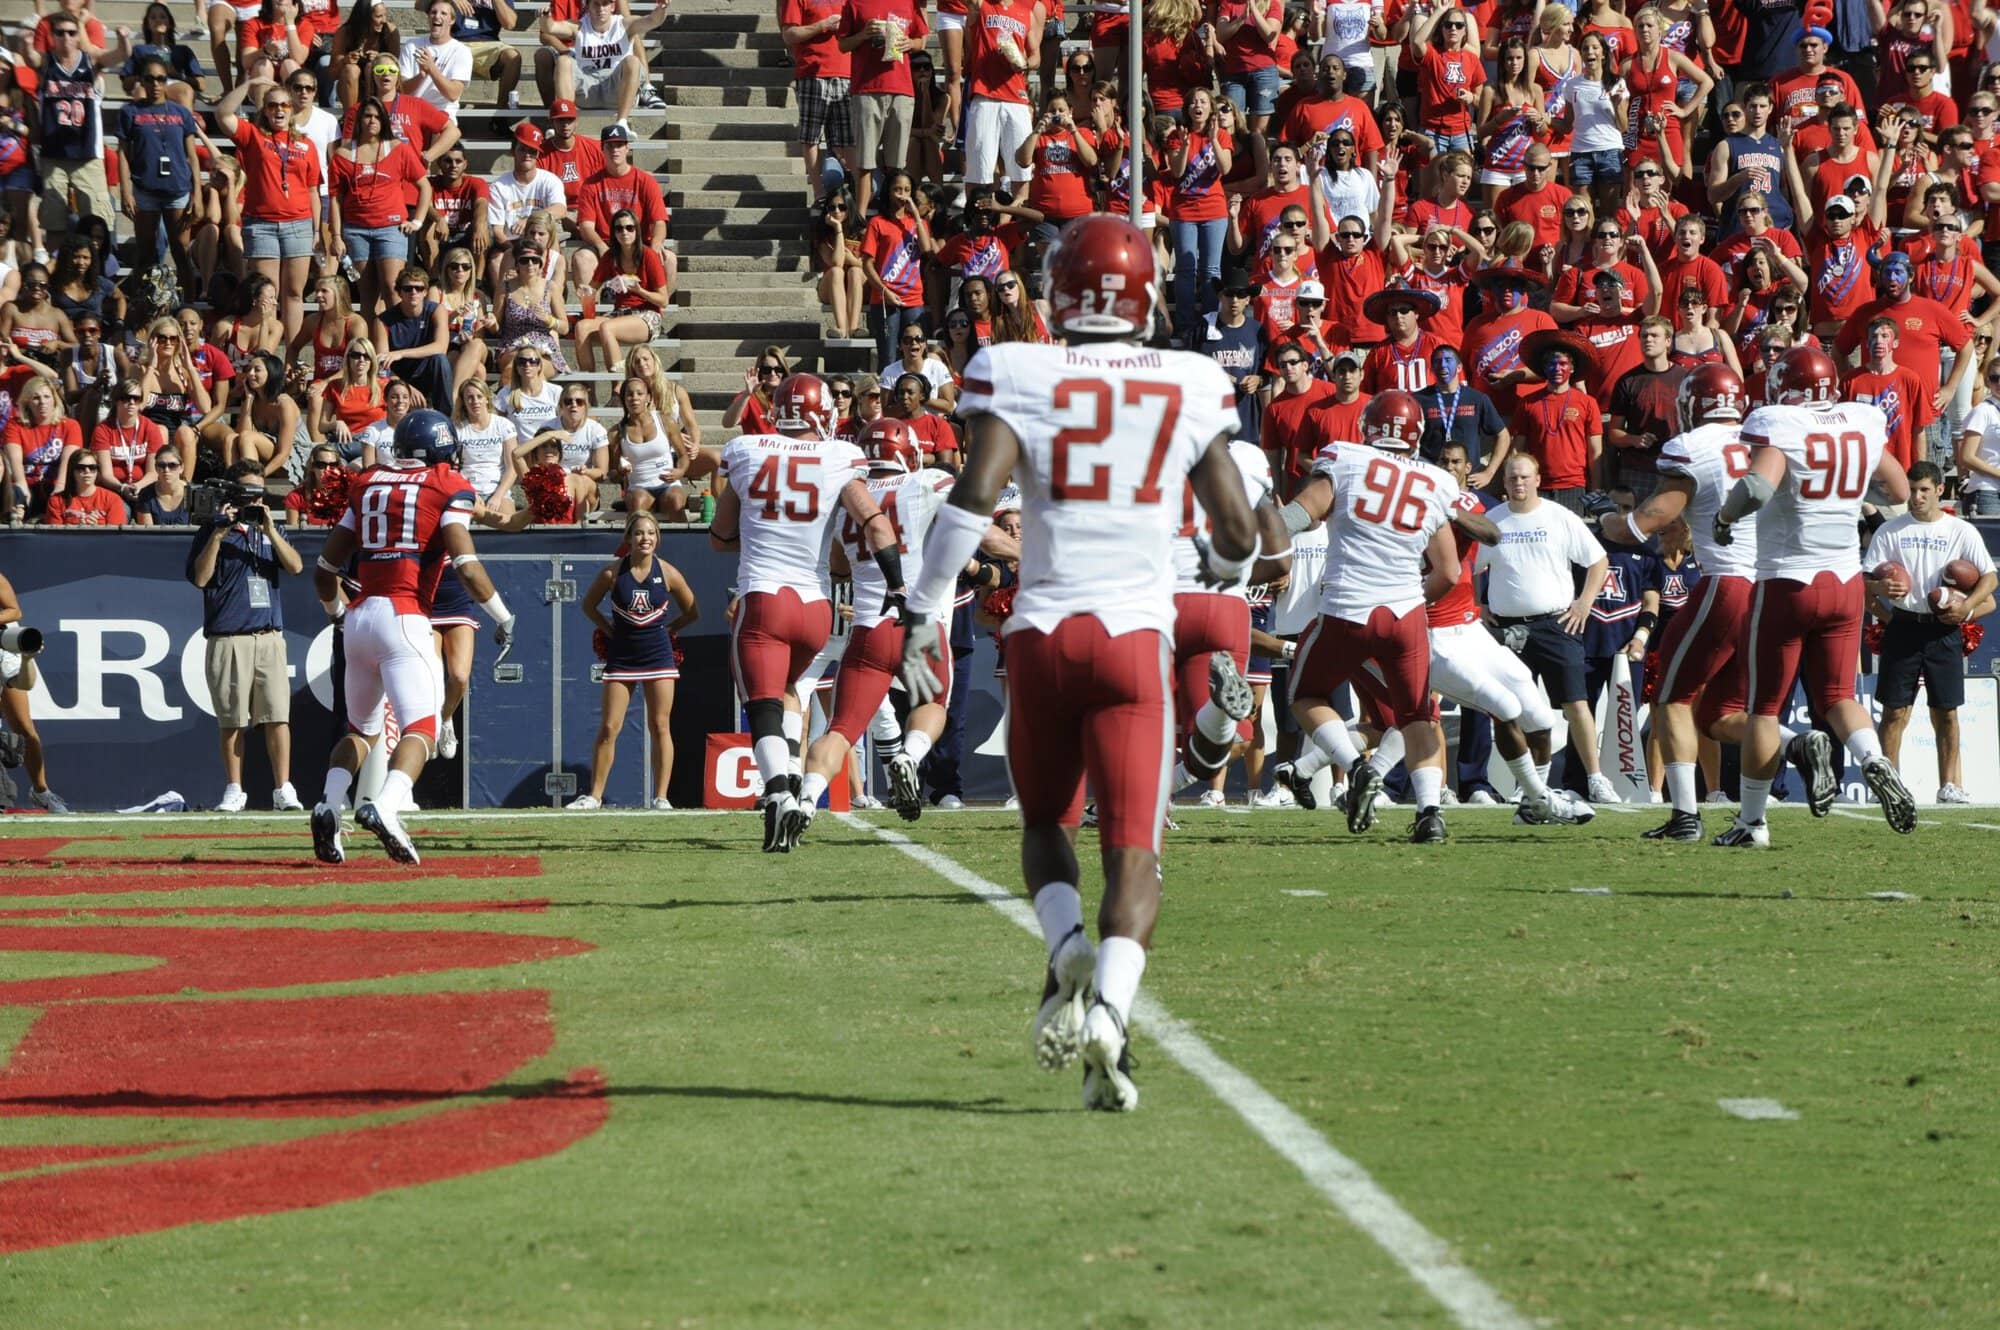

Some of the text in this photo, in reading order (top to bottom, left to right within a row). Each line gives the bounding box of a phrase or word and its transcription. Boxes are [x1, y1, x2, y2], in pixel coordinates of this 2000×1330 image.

[581, 44, 622, 59] ARIZONA
[56, 101, 86, 127] 20
[1738, 153, 1781, 174] ARIZONA
[1080, 289, 1117, 317] 27
[1396, 357, 1428, 393] 10
[1716, 393, 1736, 408] 92
[1803, 387, 1828, 402] 90
[461, 437, 503, 450] ARIZONA
[1051, 377, 1183, 504] 27
[1381, 423, 1403, 438] 96
[1801, 431, 1867, 500] 90
[748, 454, 822, 522] 45
[1355, 457, 1436, 534] 96
[360, 483, 422, 550] 81
[631, 589, 654, 613] A
[1615, 683, 1636, 775] ARIZONA
